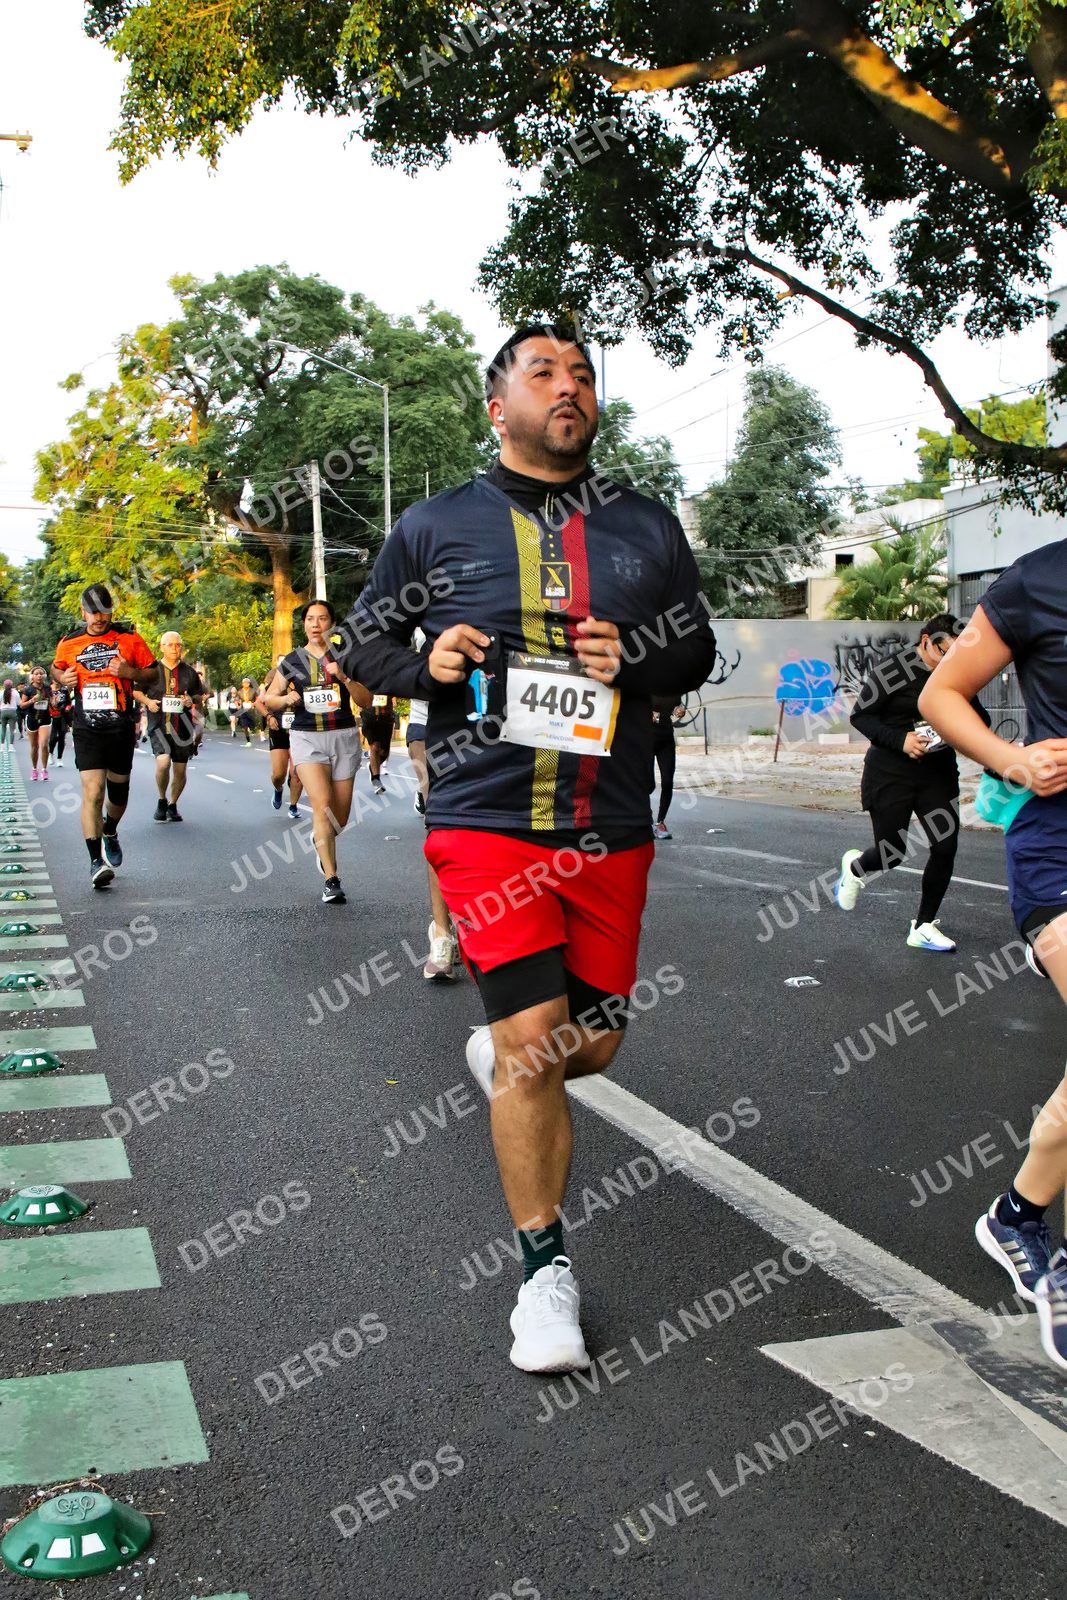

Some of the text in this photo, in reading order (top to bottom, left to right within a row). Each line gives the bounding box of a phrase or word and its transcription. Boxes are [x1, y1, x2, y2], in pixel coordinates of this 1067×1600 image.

[87, 690, 110, 700] 2344
[309, 693, 333, 704] 3830
[520, 682, 596, 719] 4405
